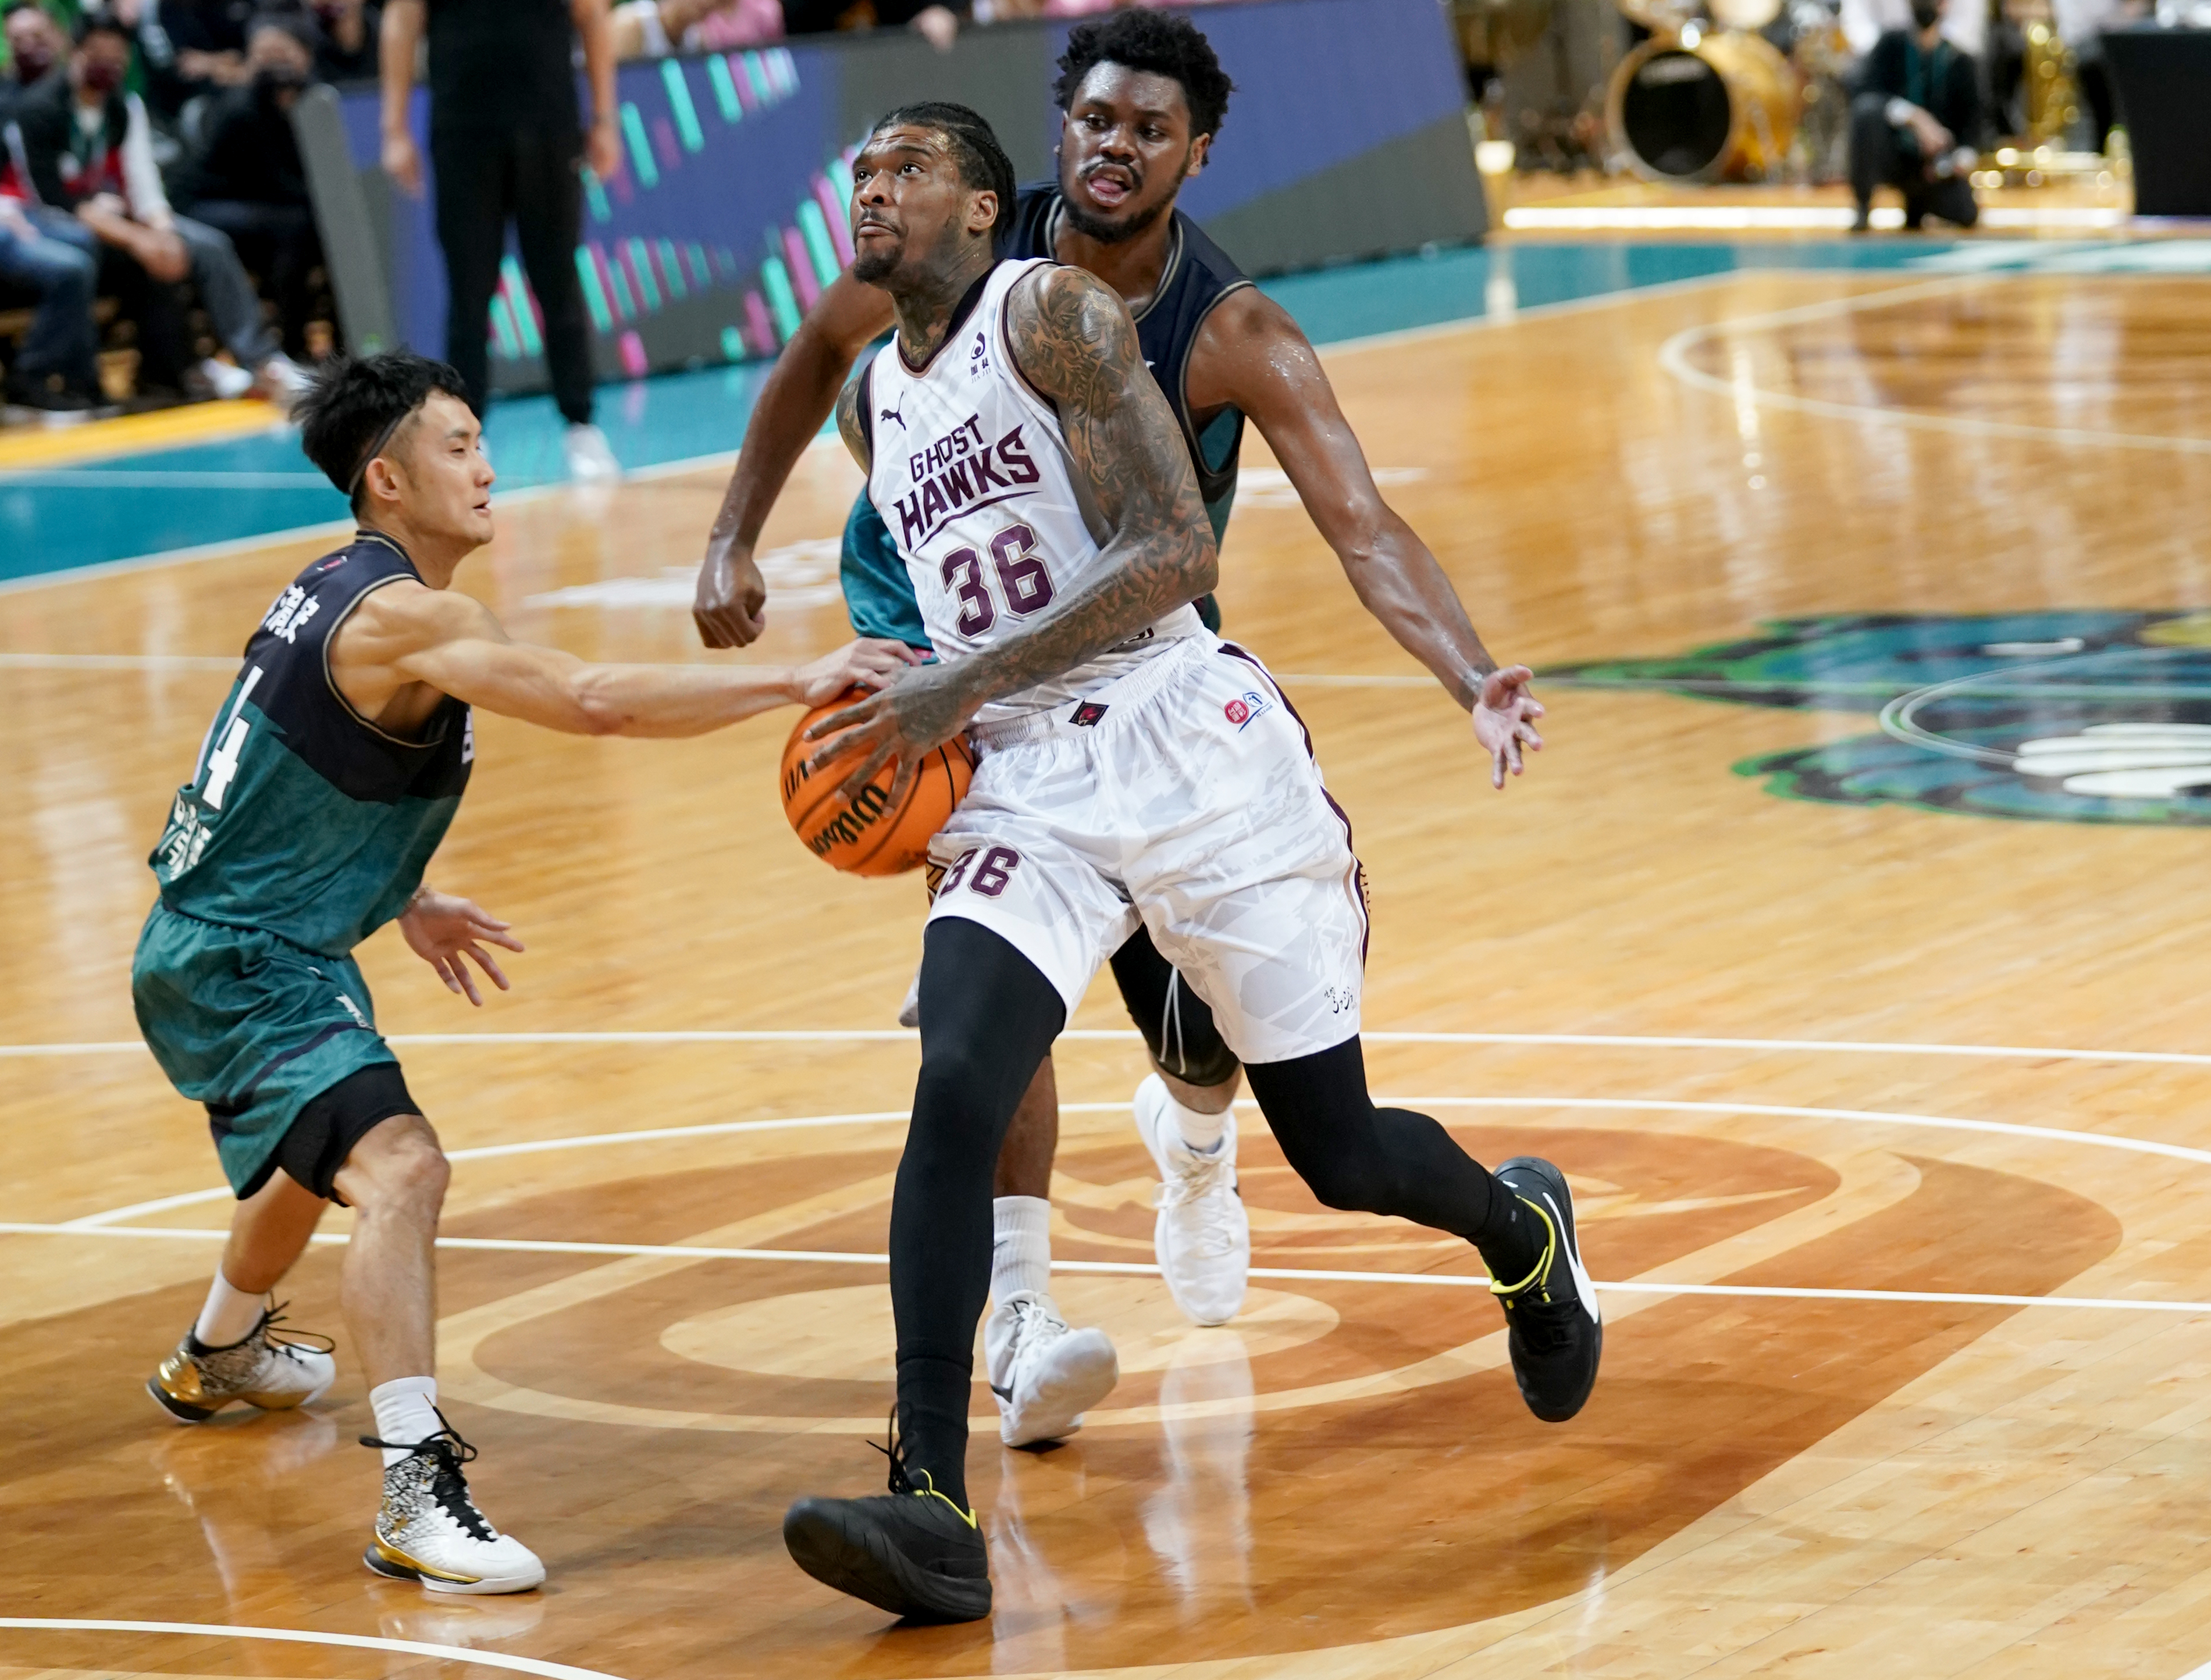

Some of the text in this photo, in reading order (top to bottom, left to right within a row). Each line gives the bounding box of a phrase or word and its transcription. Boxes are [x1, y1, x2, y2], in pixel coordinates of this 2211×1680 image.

[892, 423, 1040, 552] HAWKS
[909, 413, 983, 482] GHOST
[939, 523, 1058, 640] 36
[939, 845, 1022, 900] 36
